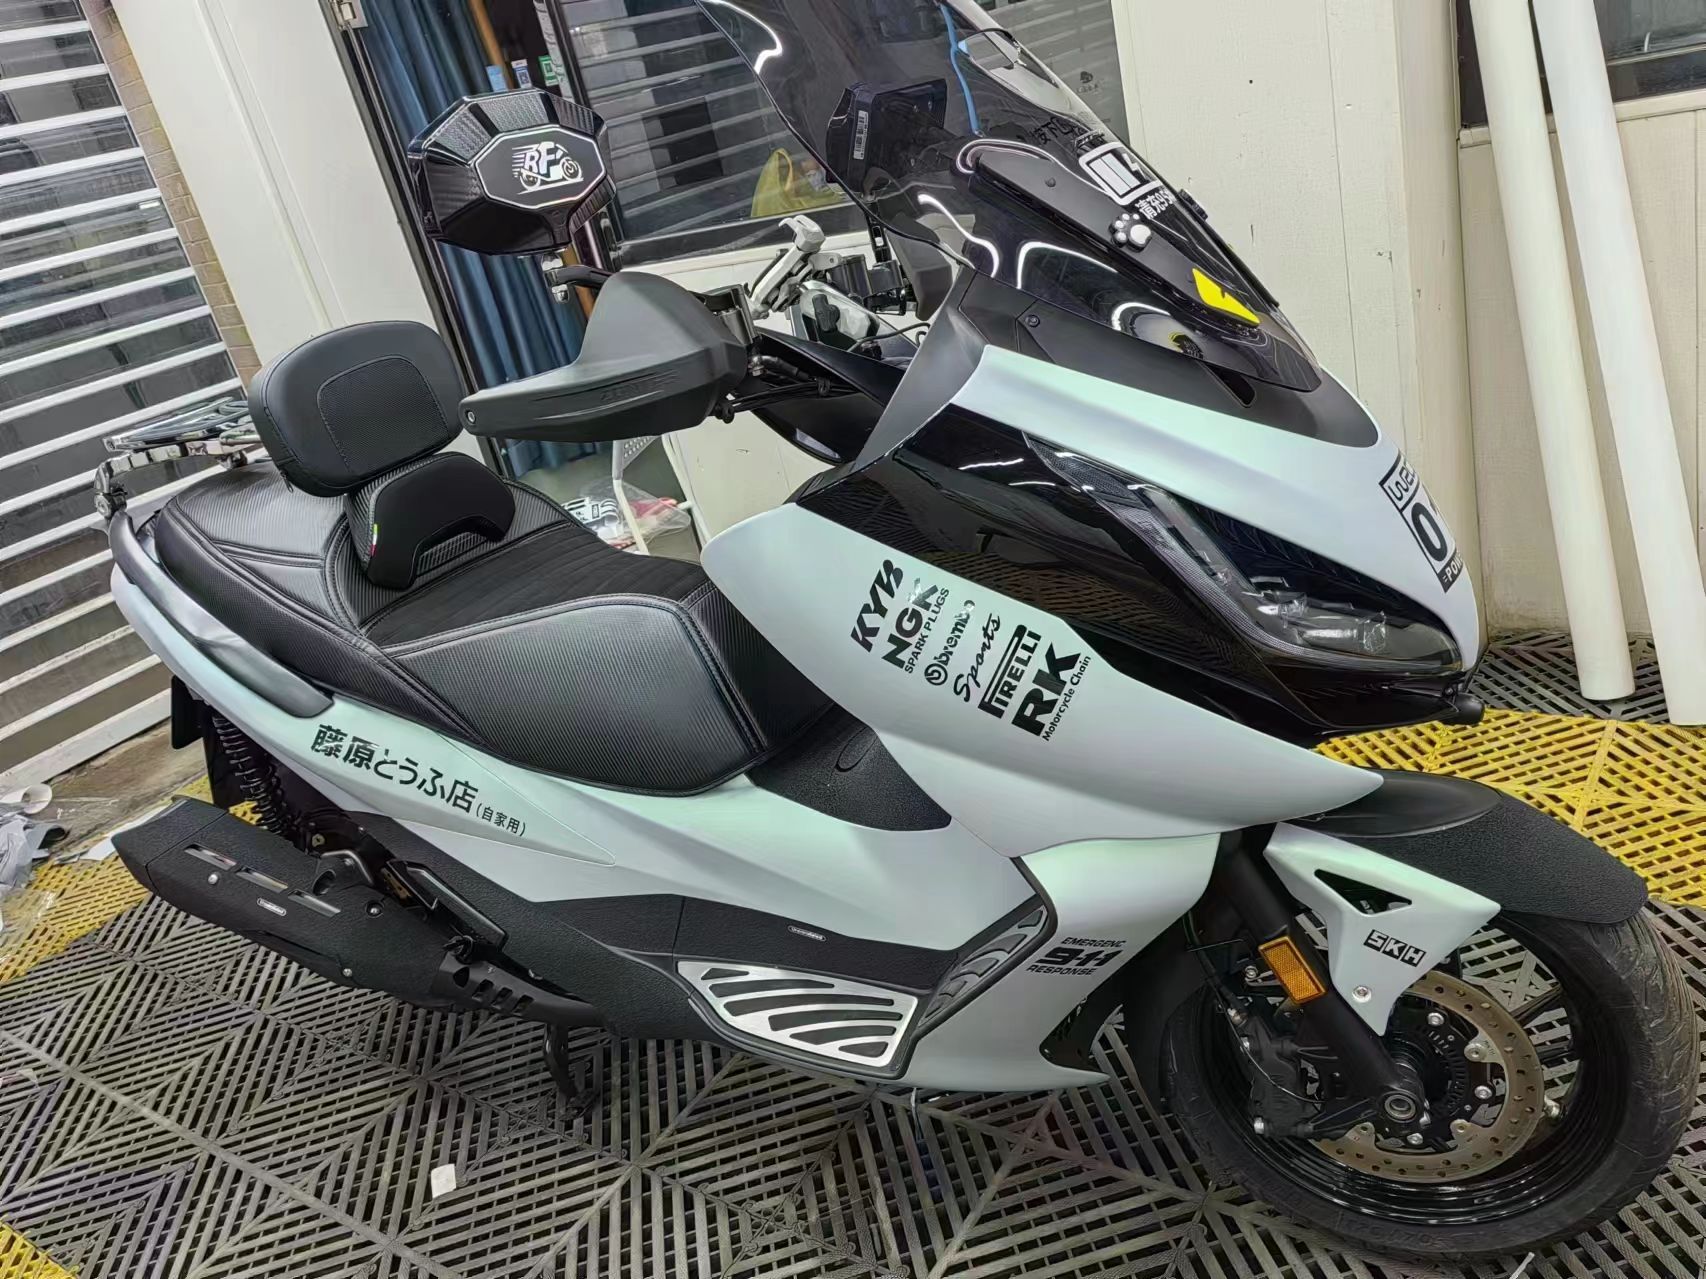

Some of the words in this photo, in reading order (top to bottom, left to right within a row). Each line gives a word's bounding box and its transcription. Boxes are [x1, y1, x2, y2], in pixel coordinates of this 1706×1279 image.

[850, 559, 904, 653] KYB
[881, 577, 939, 669] NGK
[904, 632, 929, 674] SPARK
[923, 587, 950, 632] PLUGS
[953, 613, 1000, 702] Sports
[977, 624, 1042, 719] PIRELLI
[1011, 642, 1081, 737] RK
[1042, 685, 1075, 742] Motorcycle
[1069, 655, 1092, 687] Chain
[310, 724, 479, 814] 藤原とうふ店
[1025, 964, 1098, 976] RESPONSE
[1366, 930, 1424, 966] SKH
